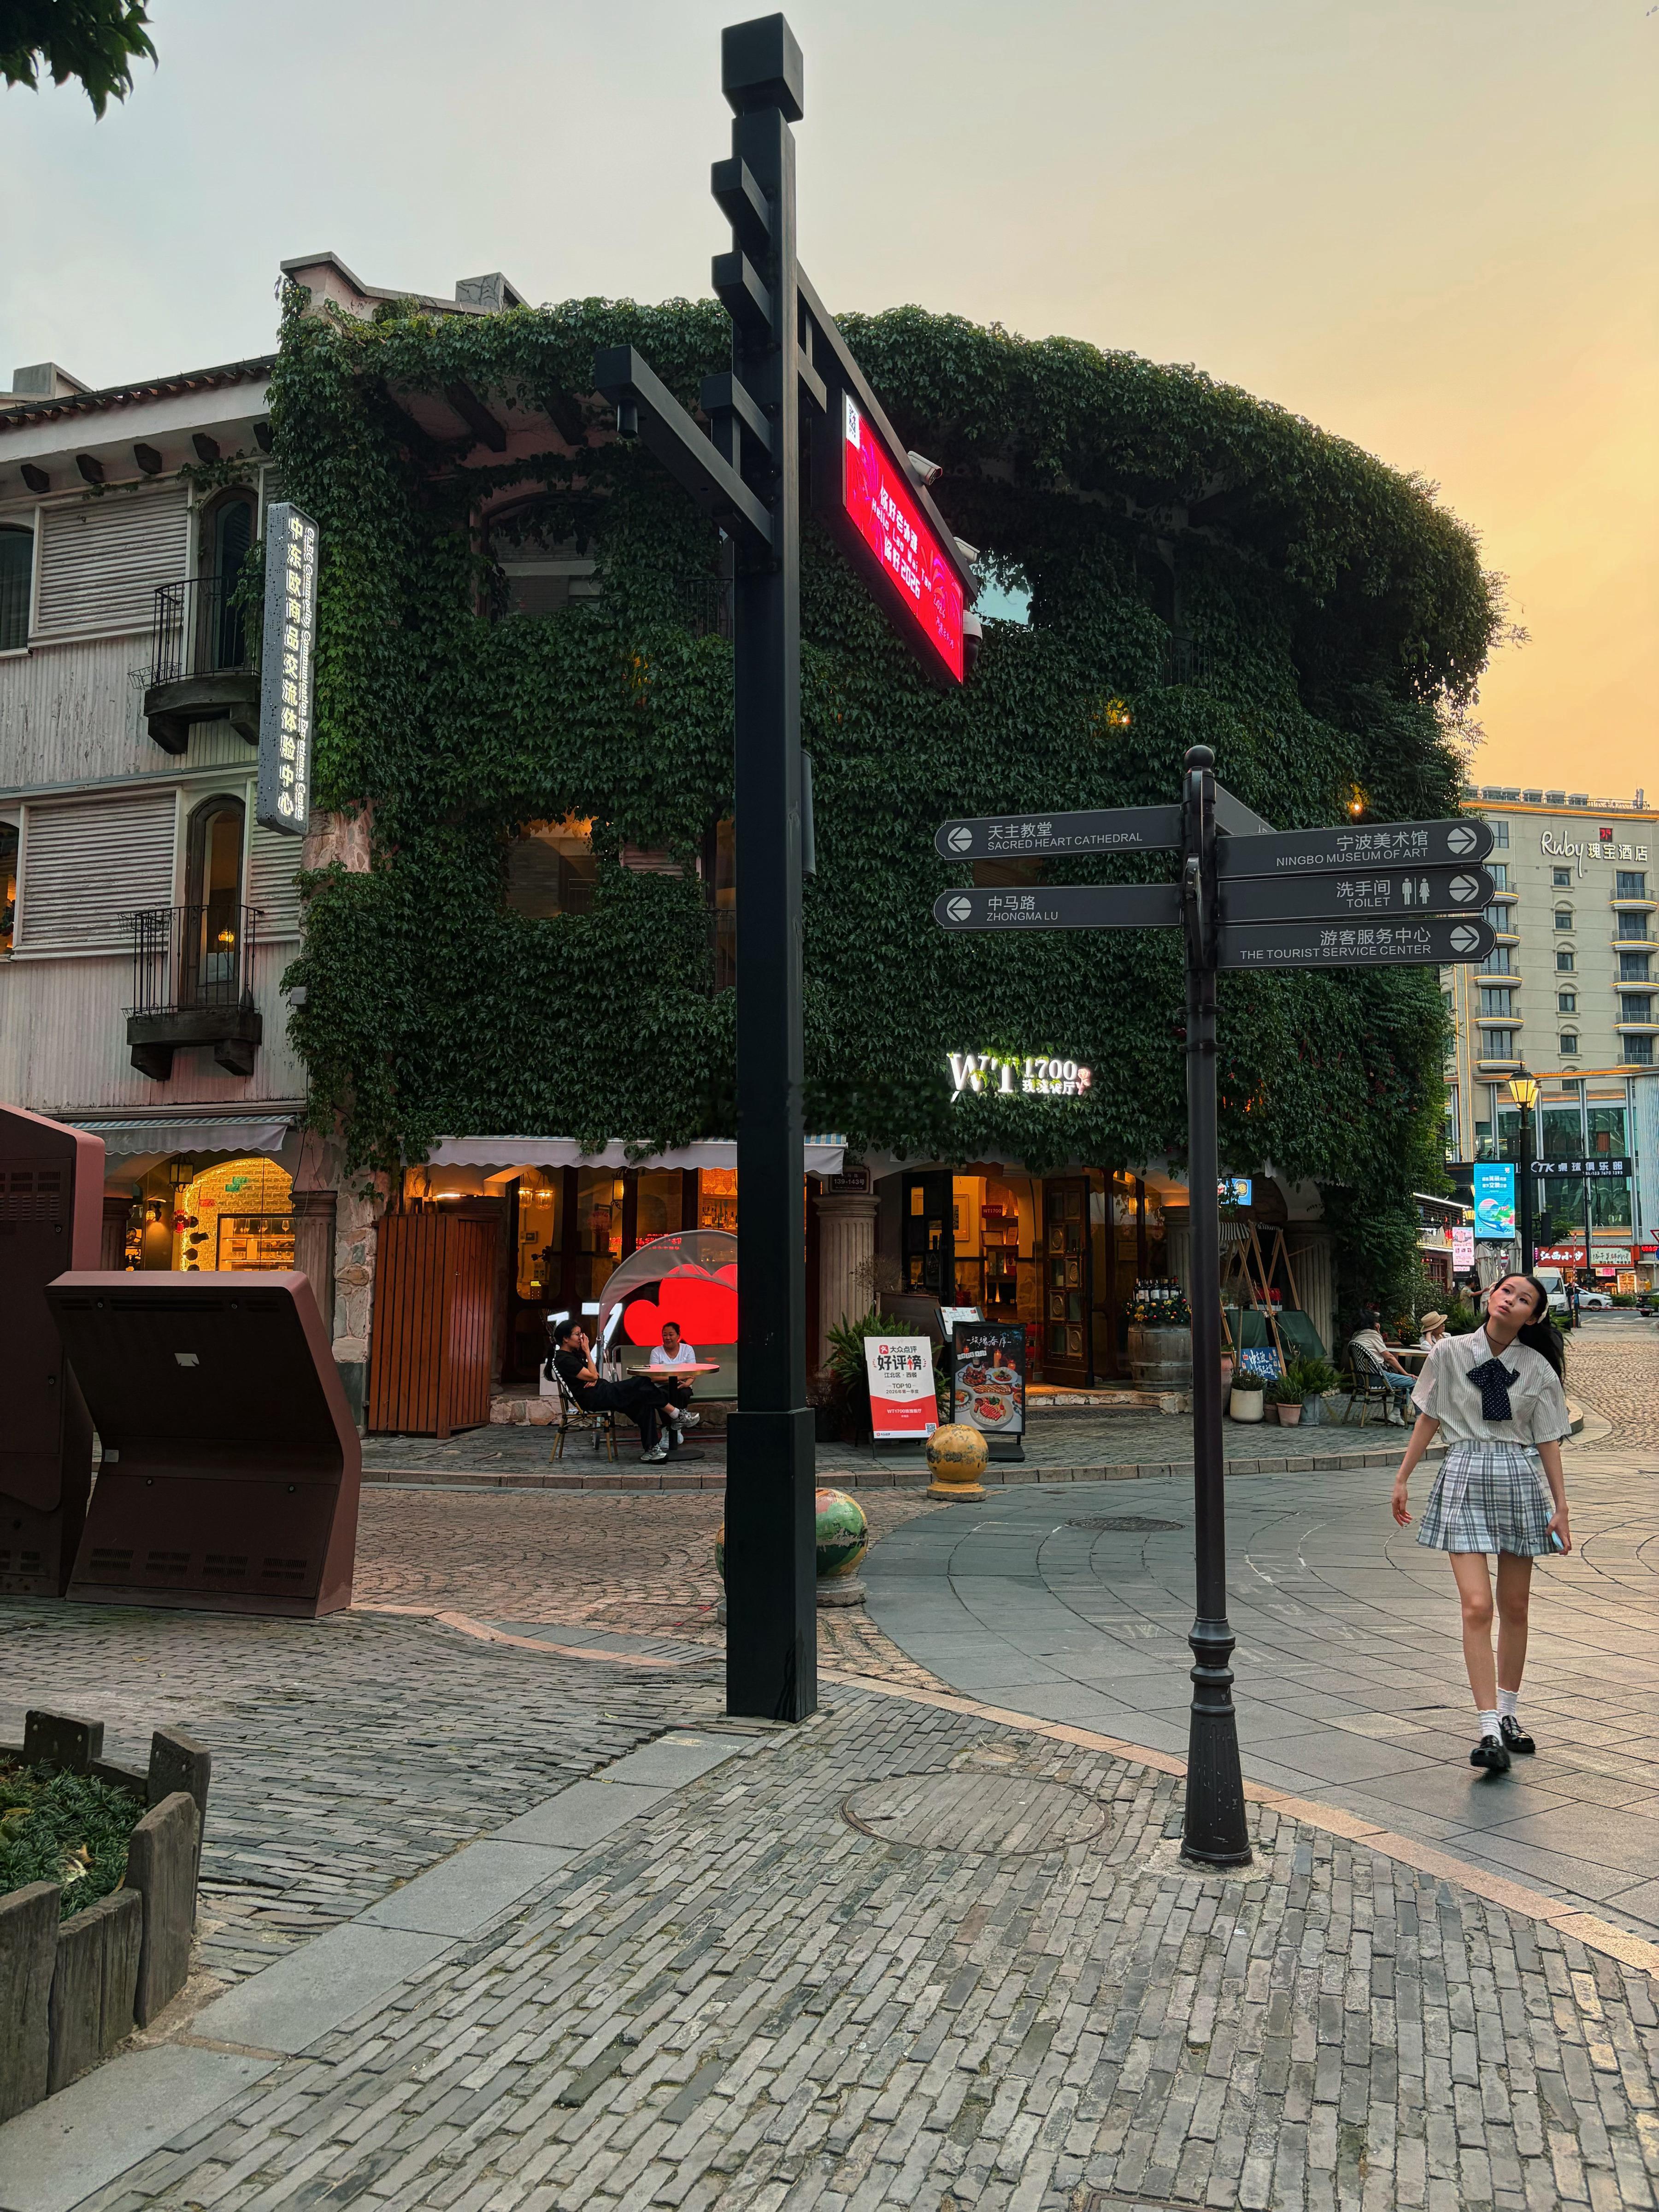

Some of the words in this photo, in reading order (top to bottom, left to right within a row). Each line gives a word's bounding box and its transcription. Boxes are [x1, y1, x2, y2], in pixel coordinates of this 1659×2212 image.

[304, 527, 314, 564] CEEC
[872, 497, 889, 530] Hello
[893, 528, 904, 553] Lao
[907, 548, 918, 572] Wai
[921, 568, 932, 592] Tan
[301, 564, 313, 629] Commodity
[277, 517, 303, 817] 中东欧商品交流体验中心
[299, 630, 311, 717] Communication
[295, 782, 306, 821] Center
[988, 822, 1052, 840] 天主教堂
[1337, 830, 1428, 851] 宁波美术馆
[988, 839, 1033, 850] SACRED
[1035, 836, 1072, 847] HEART
[1075, 833, 1142, 845] CATHEDRAL
[1277, 854, 1324, 866] NINGBO
[1327, 851, 1381, 863] MUSEUM
[1383, 849, 1400, 859] OF
[1403, 847, 1428, 858] ART
[1541, 830, 1584, 878] Ruby
[1588, 843, 1648, 862] 瑰宝酒店
[1336, 880, 1390, 898] 洗手间
[988, 895, 1035, 911] 中马路
[1347, 897, 1390, 908] TOILET
[987, 912, 1042, 921] ZHONGMA
[1044, 912, 1058, 920] LU
[1320, 927, 1431, 946] 游客服务中心
[1240, 950, 1264, 959] THE
[1266, 948, 1320, 959] TOURIST
[1323, 946, 1377, 957] SERVICE
[1380, 945, 1431, 955] CENTER
[1024, 1059, 1078, 1080] 1700
[1558, 1161, 1623, 1171] 桌球俱乐部
[877, 1355, 922, 1371] 好评榜
